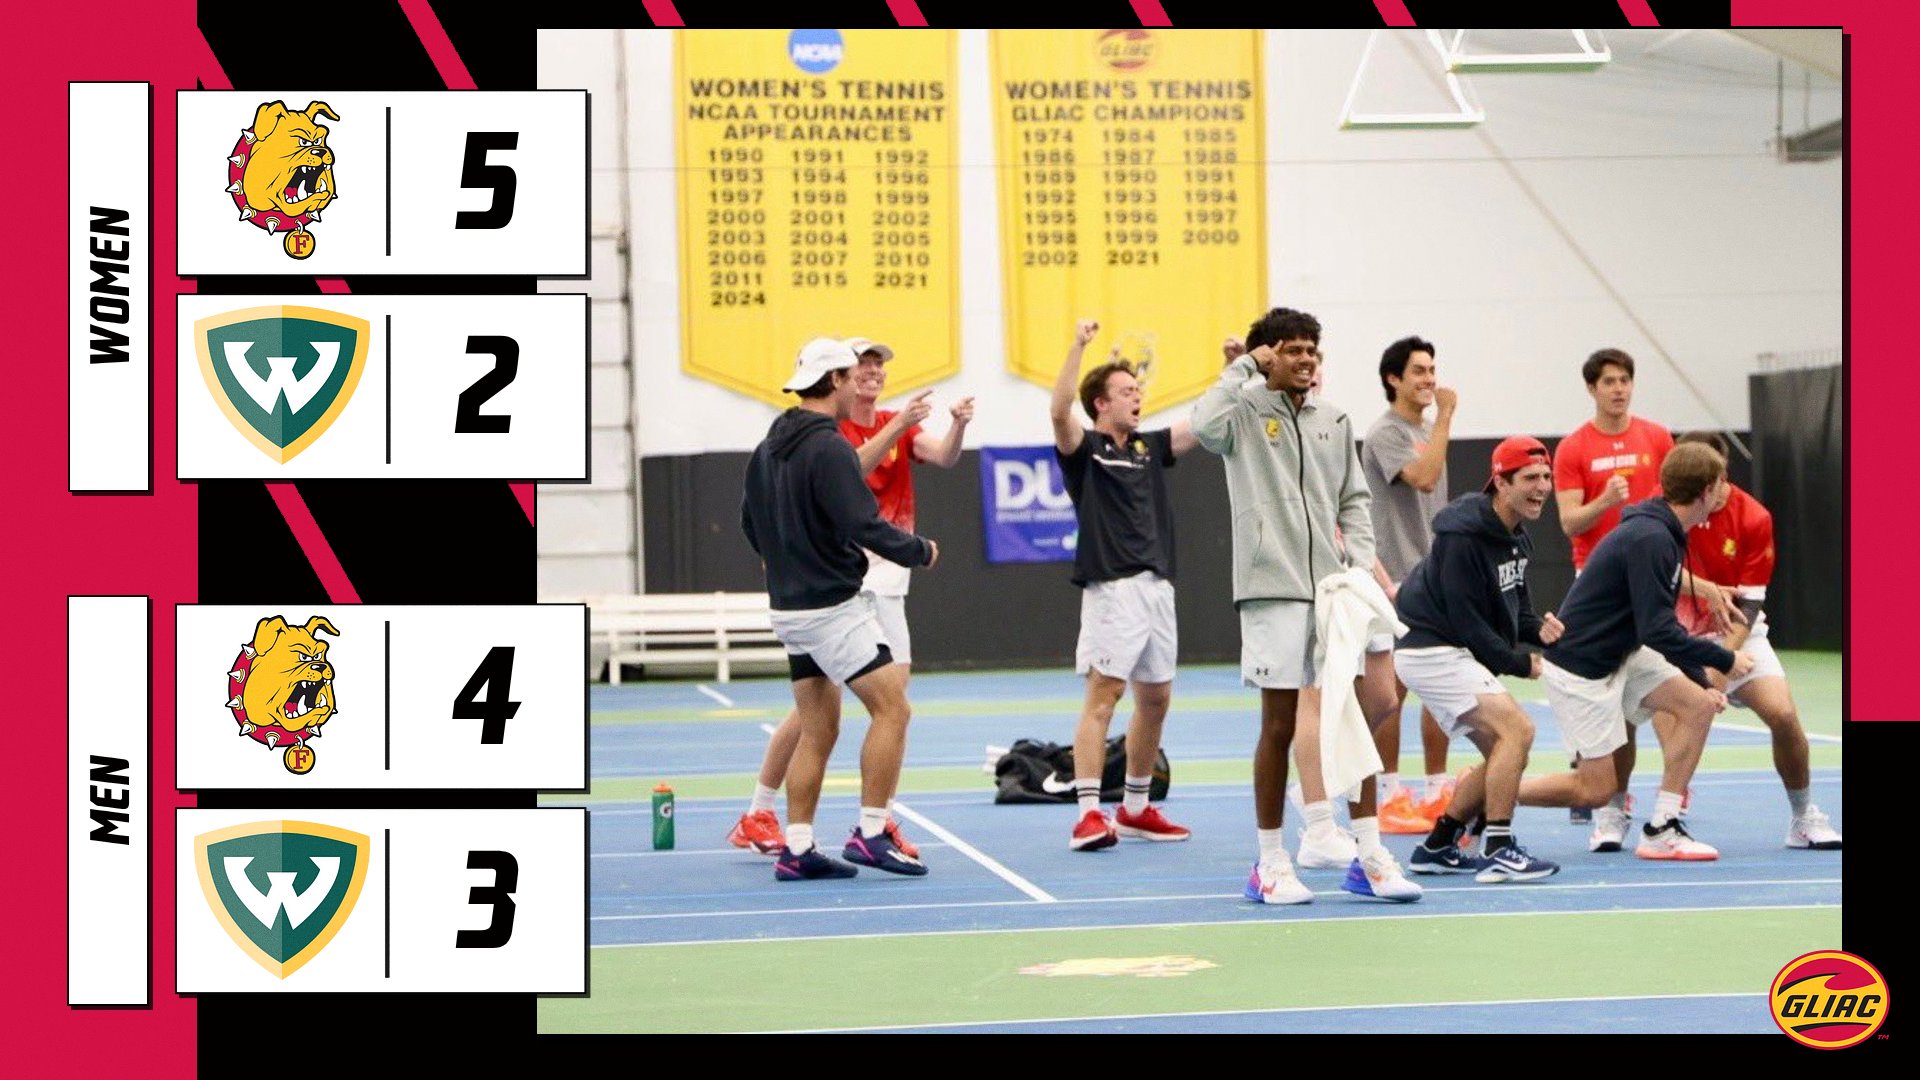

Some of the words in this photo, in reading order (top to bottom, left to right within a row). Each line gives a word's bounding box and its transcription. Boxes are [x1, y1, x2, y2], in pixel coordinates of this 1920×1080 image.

[690, 78, 827, 99] WOMEN'S
[838, 79, 945, 101] TENNIS
[1005, 80, 1138, 101] WOMEN'S
[1148, 80, 1253, 100] TENNIS
[688, 103, 759, 121] NCAA
[769, 103, 946, 123] TOURNAMENT
[1012, 103, 1085, 122] GLIAC
[1094, 104, 1246, 122] CHAMPIONS
[722, 123, 913, 143] APPEARANCES
[1023, 128, 1073, 144] 1974
[1103, 128, 1155, 144] 1984
[1184, 129, 1236, 143] 1985
[709, 147, 764, 164] 1990
[792, 148, 843, 164] 1991
[875, 150, 928, 165] 1992
[1023, 149, 1075, 166] 1986
[1104, 148, 1155, 166] 1987
[1184, 148, 1238, 165] 1988
[709, 168, 763, 184] 1993
[792, 167, 847, 184] 1994
[876, 169, 929, 185] 1996
[1024, 168, 1076, 185] 1989
[1104, 169, 1157, 184] 1990
[1185, 170, 1234, 184] 1991
[710, 189, 763, 205] 1997
[792, 189, 847, 205] 1998
[875, 190, 929, 205] 1999
[1025, 189, 1076, 206] 1992
[1104, 189, 1156, 204] 1993
[1186, 189, 1237, 204] 1994
[707, 209, 766, 226] 2000
[790, 209, 844, 225] 2001
[873, 211, 930, 226] 2002
[1025, 209, 1077, 226] 1995
[1104, 209, 1157, 224] 1996
[1186, 209, 1236, 224] 1997
[708, 230, 766, 246] 2003
[791, 230, 848, 246] 2004
[873, 231, 930, 246] 2005
[1026, 229, 1077, 246] 1998
[1105, 230, 1158, 245] 1999
[1183, 229, 1239, 245] 2000
[708, 250, 766, 266] 2006
[791, 250, 847, 266] 2007
[875, 251, 930, 267] 2010
[1024, 250, 1078, 267] 2002
[1107, 250, 1159, 266] 2021
[711, 270, 762, 288] 2011
[792, 271, 847, 287] 2015
[874, 271, 928, 289] 2021
[711, 290, 766, 307] 2024
